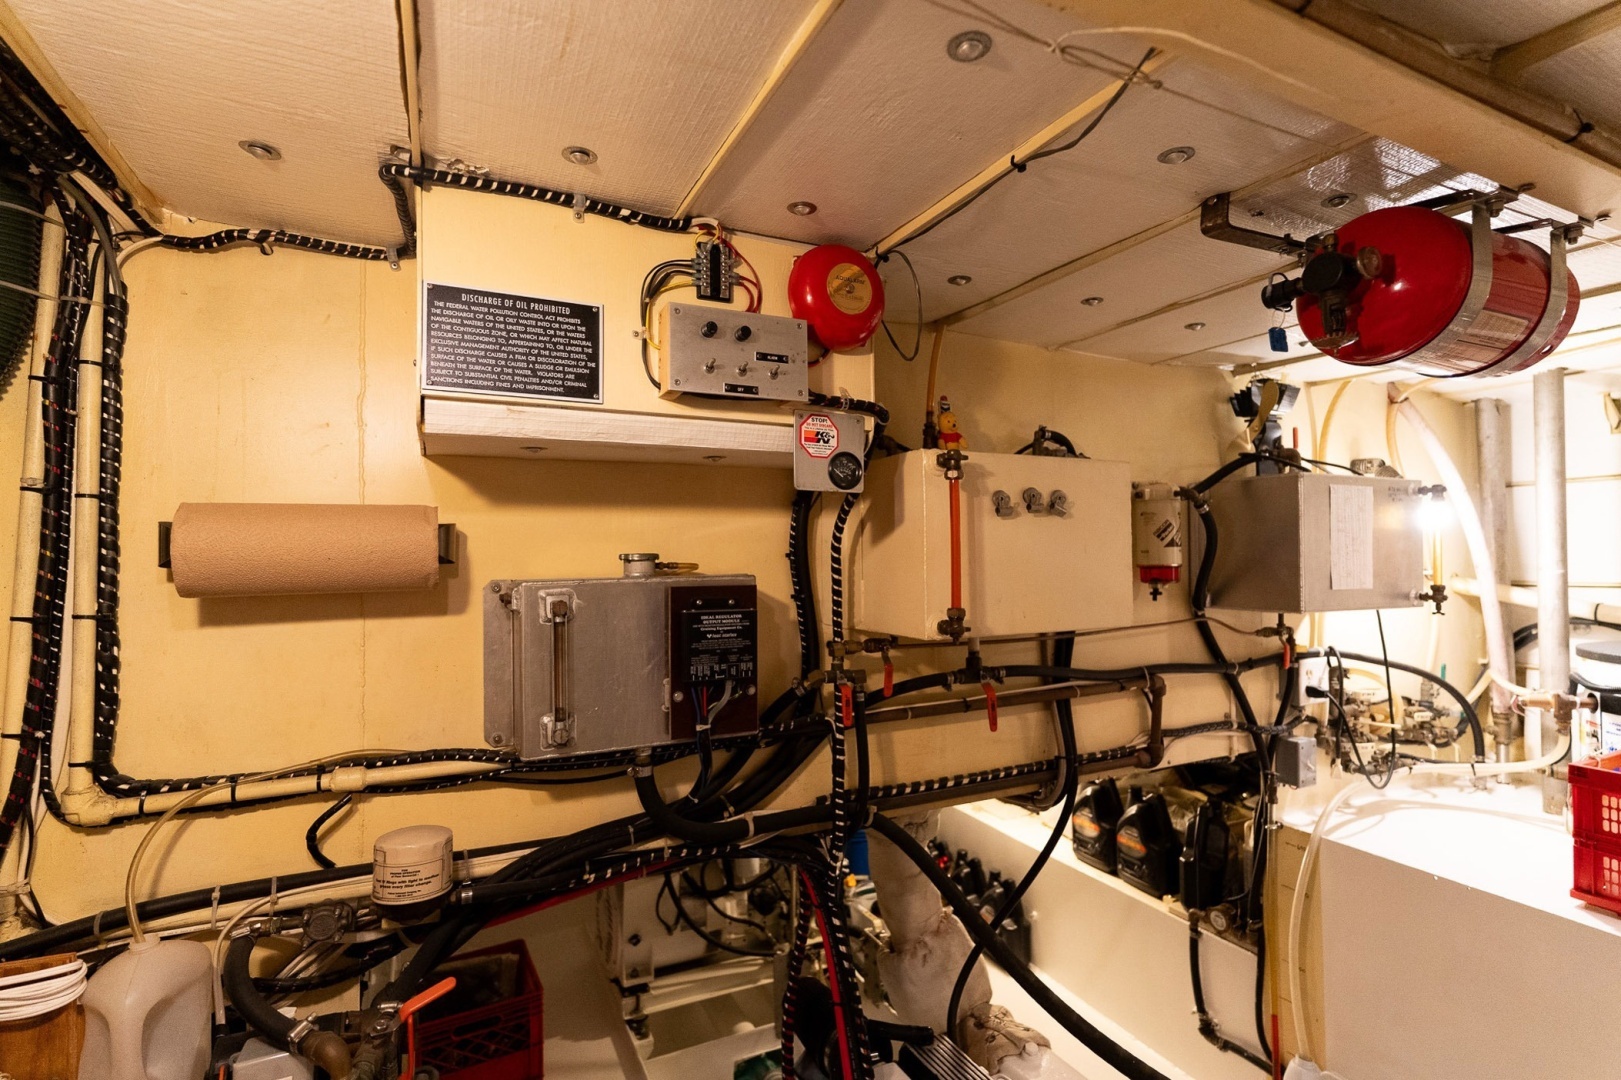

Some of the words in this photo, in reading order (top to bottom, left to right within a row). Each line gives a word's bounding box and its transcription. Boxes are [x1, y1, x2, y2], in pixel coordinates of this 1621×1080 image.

[446, 302, 468, 310] FEDERAL
[490, 308, 518, 316] POLLUTION
[462, 294, 502, 306] DISCHARGE
[516, 300, 527, 309] OIL
[531, 303, 570, 314] PROHIBITED
[443, 310, 474, 318] DISCHARGE
[431, 316, 461, 324] NAVIGABLE
[527, 327, 545, 335] STATES,
[453, 326, 489, 334] CONTIGUOUS
[431, 331, 462, 339] RESOURCES
[464, 334, 496, 342] BELONGING
[508, 338, 544, 348] APPERTAINING
[461, 342, 500, 350] MANAGEMENT
[501, 346, 529, 354] AUTHORITY
[538, 357, 577, 366] DISCOLORATION
[465, 371, 498, 379] SUBSTANTIAL
[526, 384, 564, 392] IMPRISONMENT.
